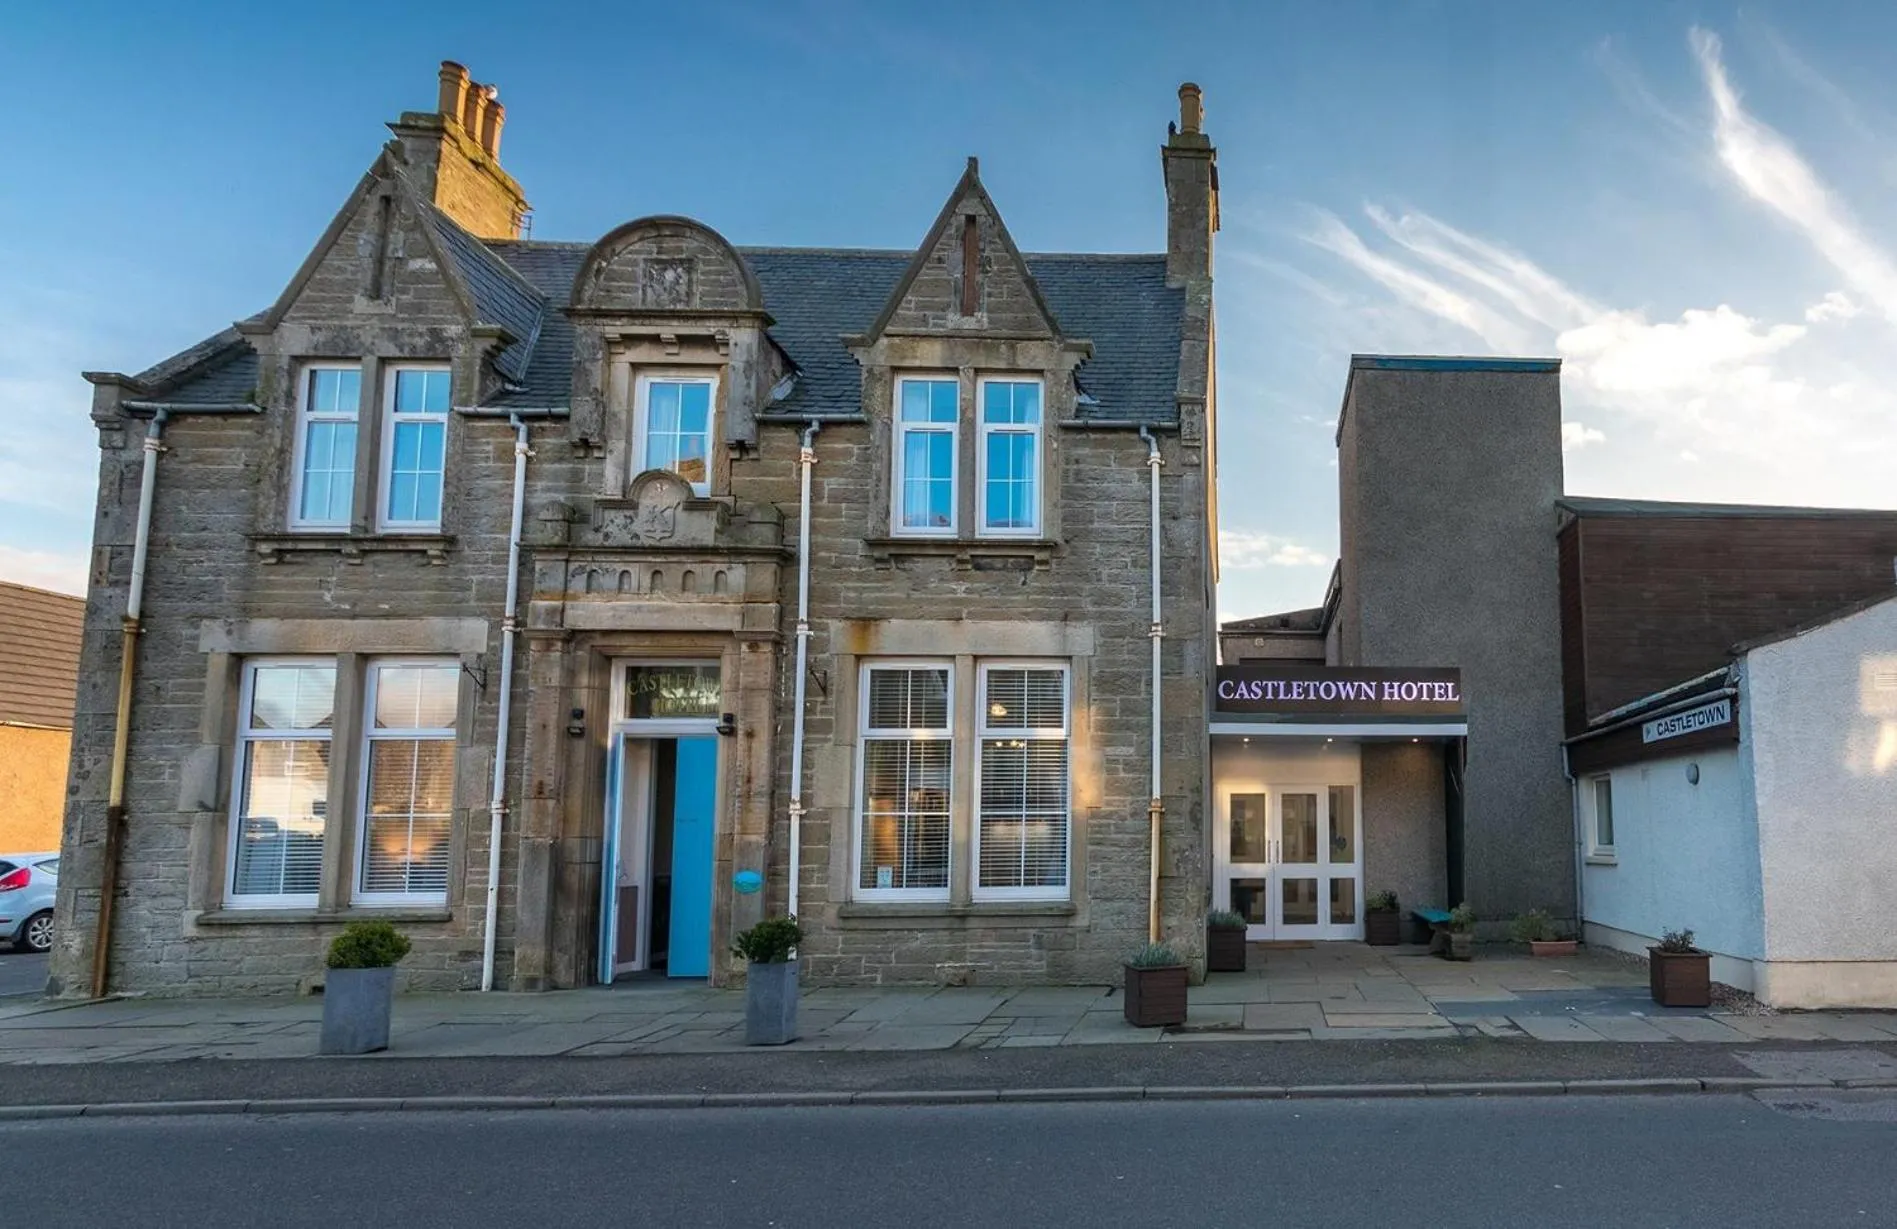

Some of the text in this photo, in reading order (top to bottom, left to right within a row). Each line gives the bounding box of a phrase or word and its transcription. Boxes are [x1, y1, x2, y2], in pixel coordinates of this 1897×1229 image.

[1217, 680, 1460, 702] CASTLETOWN HOTEL
[1656, 704, 1725, 736] CASTLETOWN
